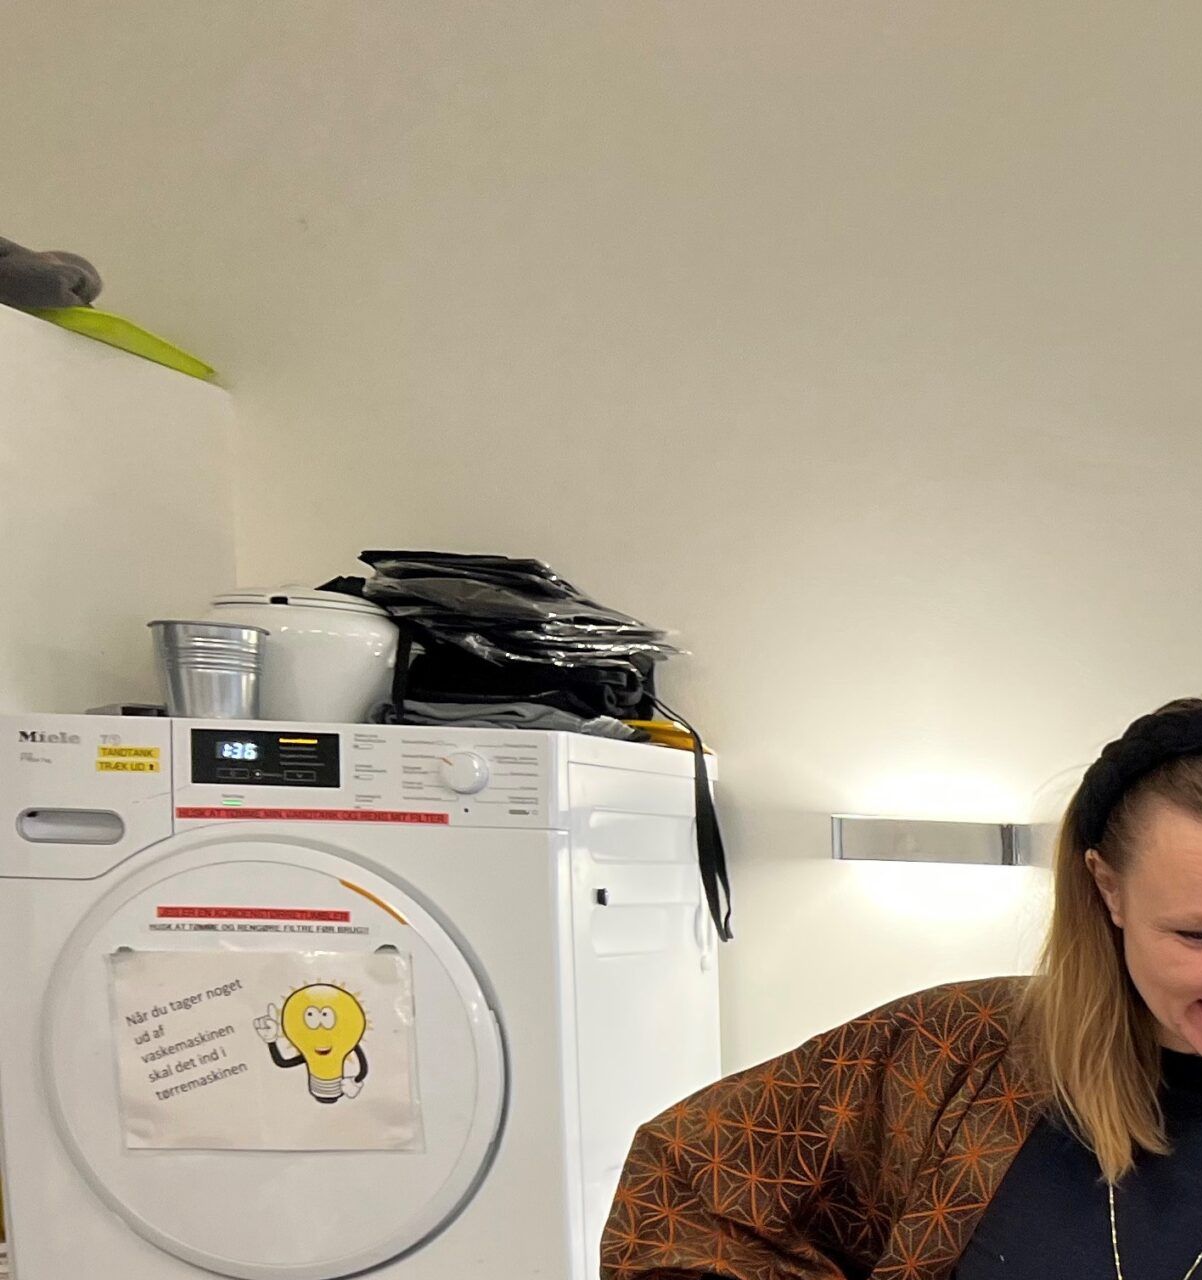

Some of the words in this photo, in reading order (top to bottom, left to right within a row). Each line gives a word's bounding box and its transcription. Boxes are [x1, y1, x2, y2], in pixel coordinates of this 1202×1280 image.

[18, 730, 81, 744] Miele
[125, 1010, 149, 1027] Når
[152, 1003, 168, 1019] du
[170, 993, 203, 1012] tager
[206, 978, 243, 1000] noget
[134, 1030, 151, 1045] ud
[153, 1025, 165, 1041] af
[141, 1023, 235, 1064] vaskemaskinen
[148, 1065, 173, 1083] skal
[177, 1059, 197, 1075] det
[198, 1050, 220, 1068] ind
[155, 1062, 249, 1101] tørremaskinen
